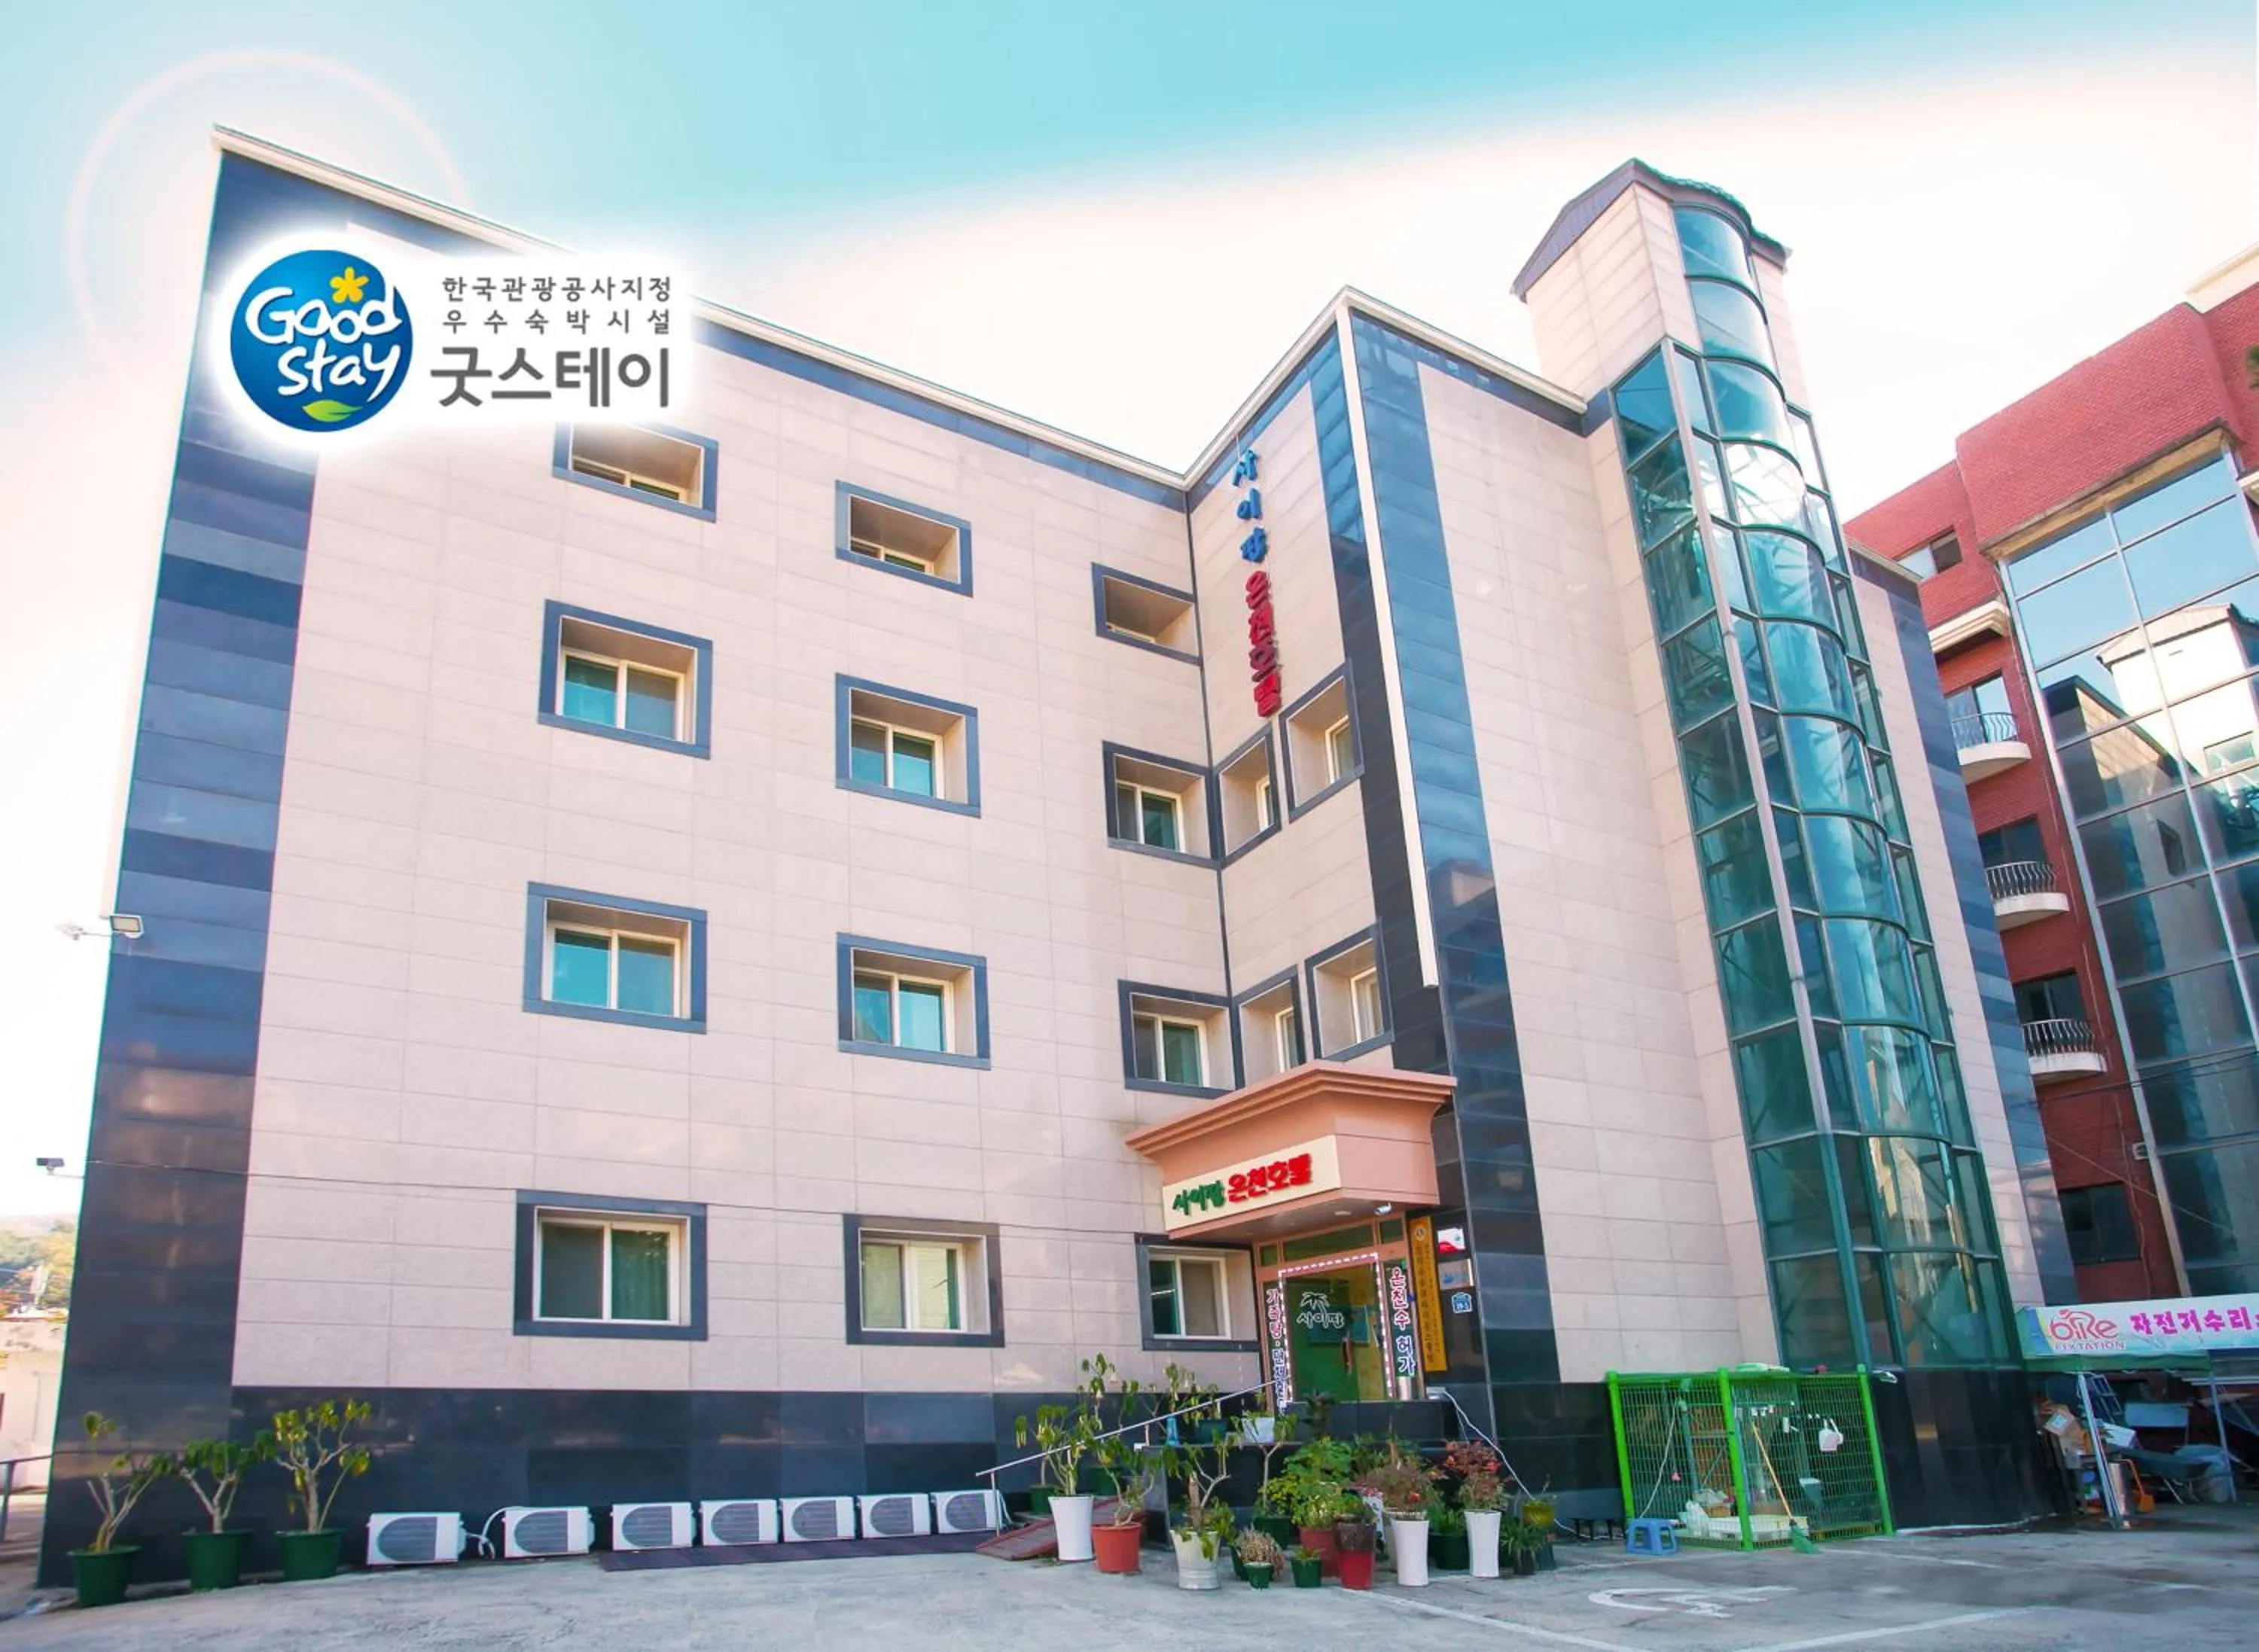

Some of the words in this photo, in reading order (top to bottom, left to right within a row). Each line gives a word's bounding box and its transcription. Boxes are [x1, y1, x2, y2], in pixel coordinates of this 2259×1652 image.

[1228, 1154, 1312, 1202] 온천호텔
[1296, 1310, 1345, 1330] 사이판
[1390, 1266, 1411, 1330] 온천수
[1396, 1335, 1416, 1377] 허가
